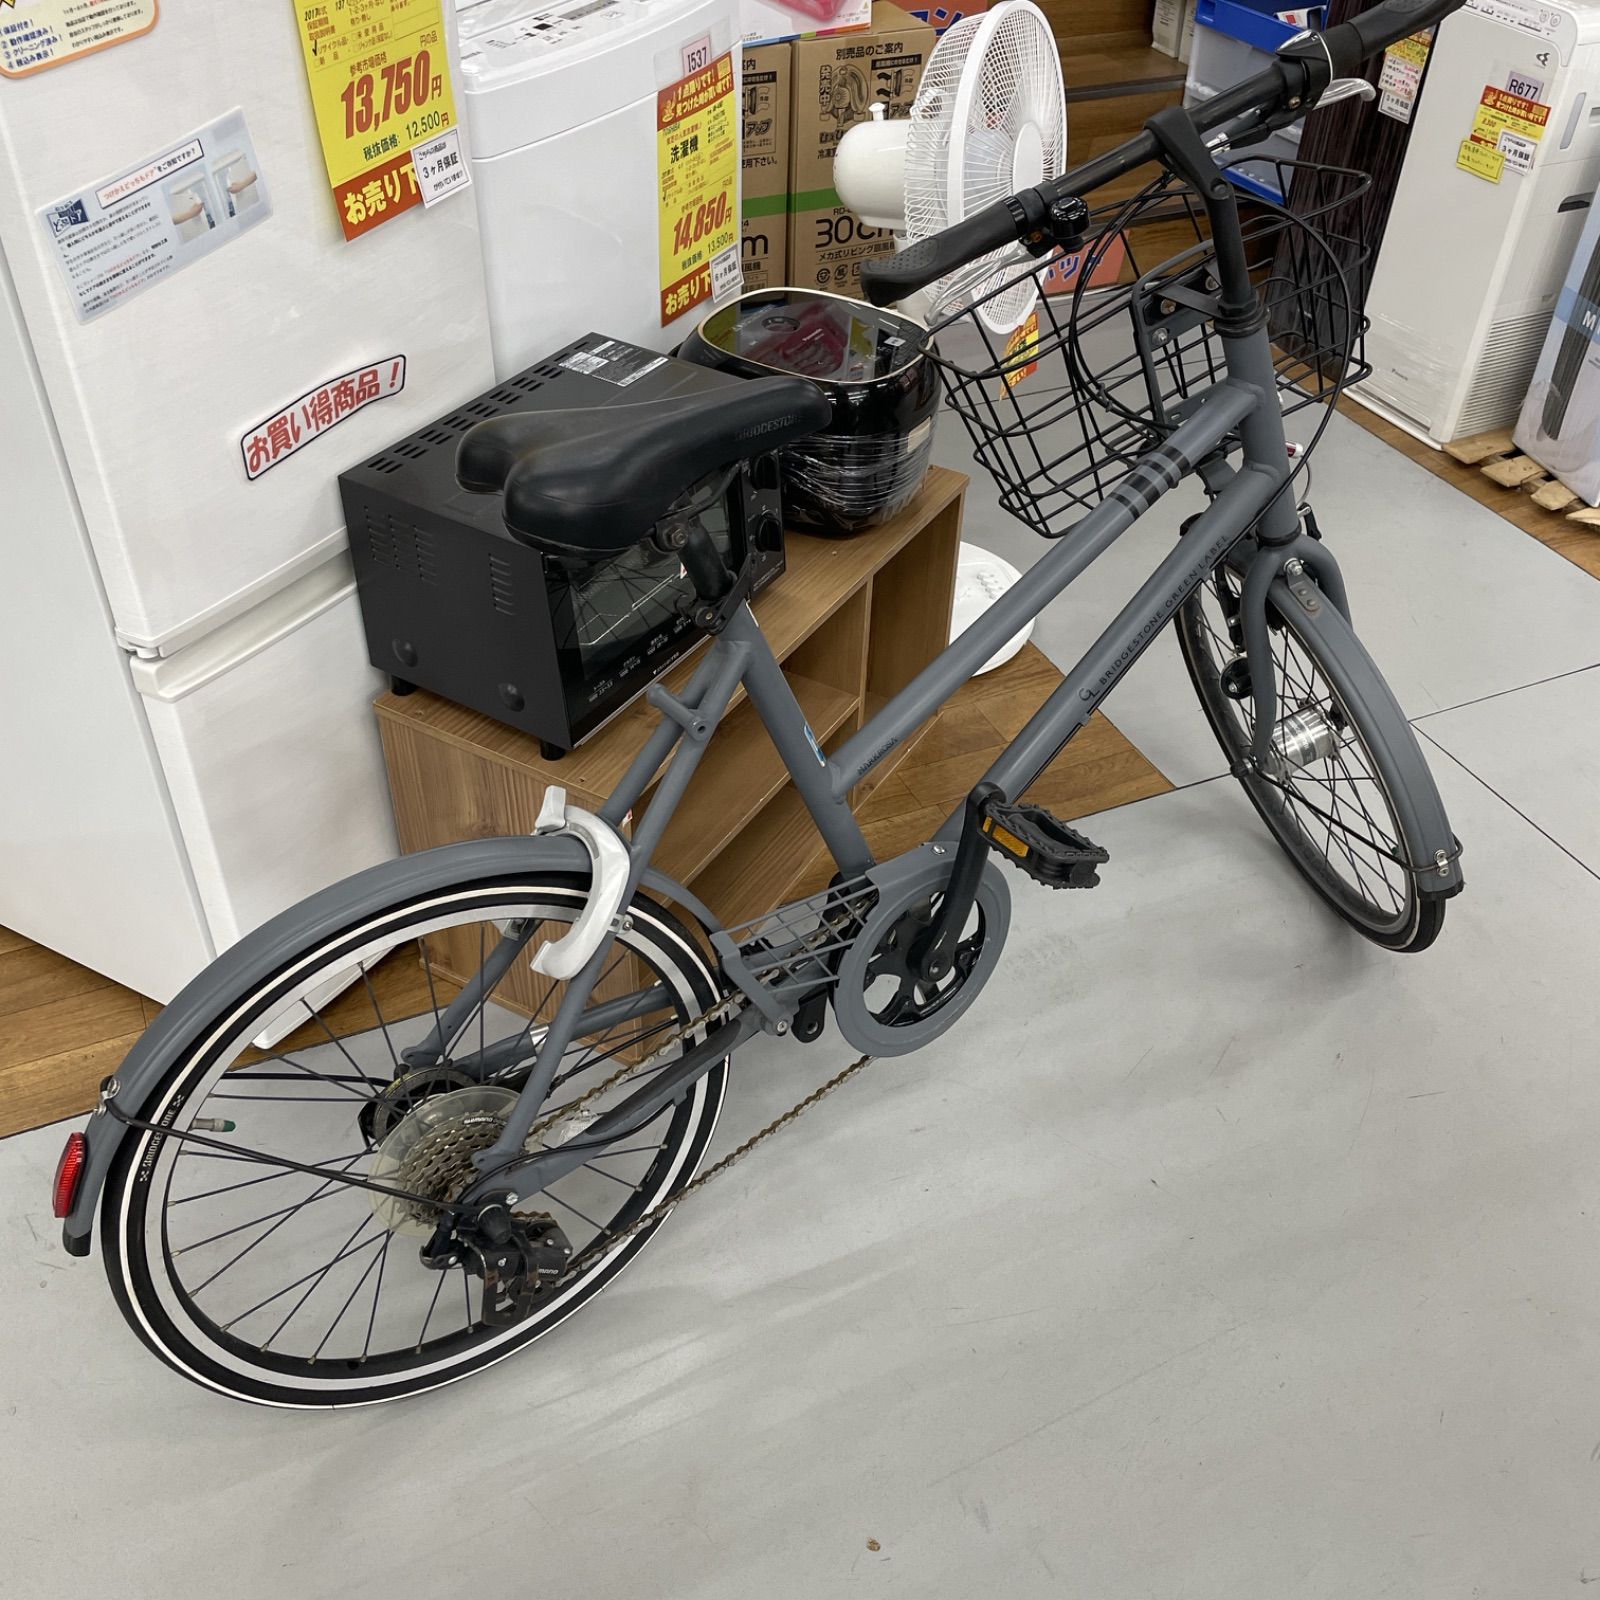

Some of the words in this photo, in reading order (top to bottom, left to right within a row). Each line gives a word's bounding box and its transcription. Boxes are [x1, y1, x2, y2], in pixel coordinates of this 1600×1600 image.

[836, 42, 904, 60] 別売品のご案内
[1508, 79, 1539, 101] R677
[670, 135, 698, 165] 洗濯機
[247, 362, 400, 473] お買い得商品！
[1098, 613, 1164, 685] BRIDGESTONE
[1165, 569, 1198, 608] GREEN
[1198, 535, 1229, 569] LABEL
[464, 1117, 493, 1125] SHIMANO
[142, 1109, 176, 1167] BRIDGEONE
